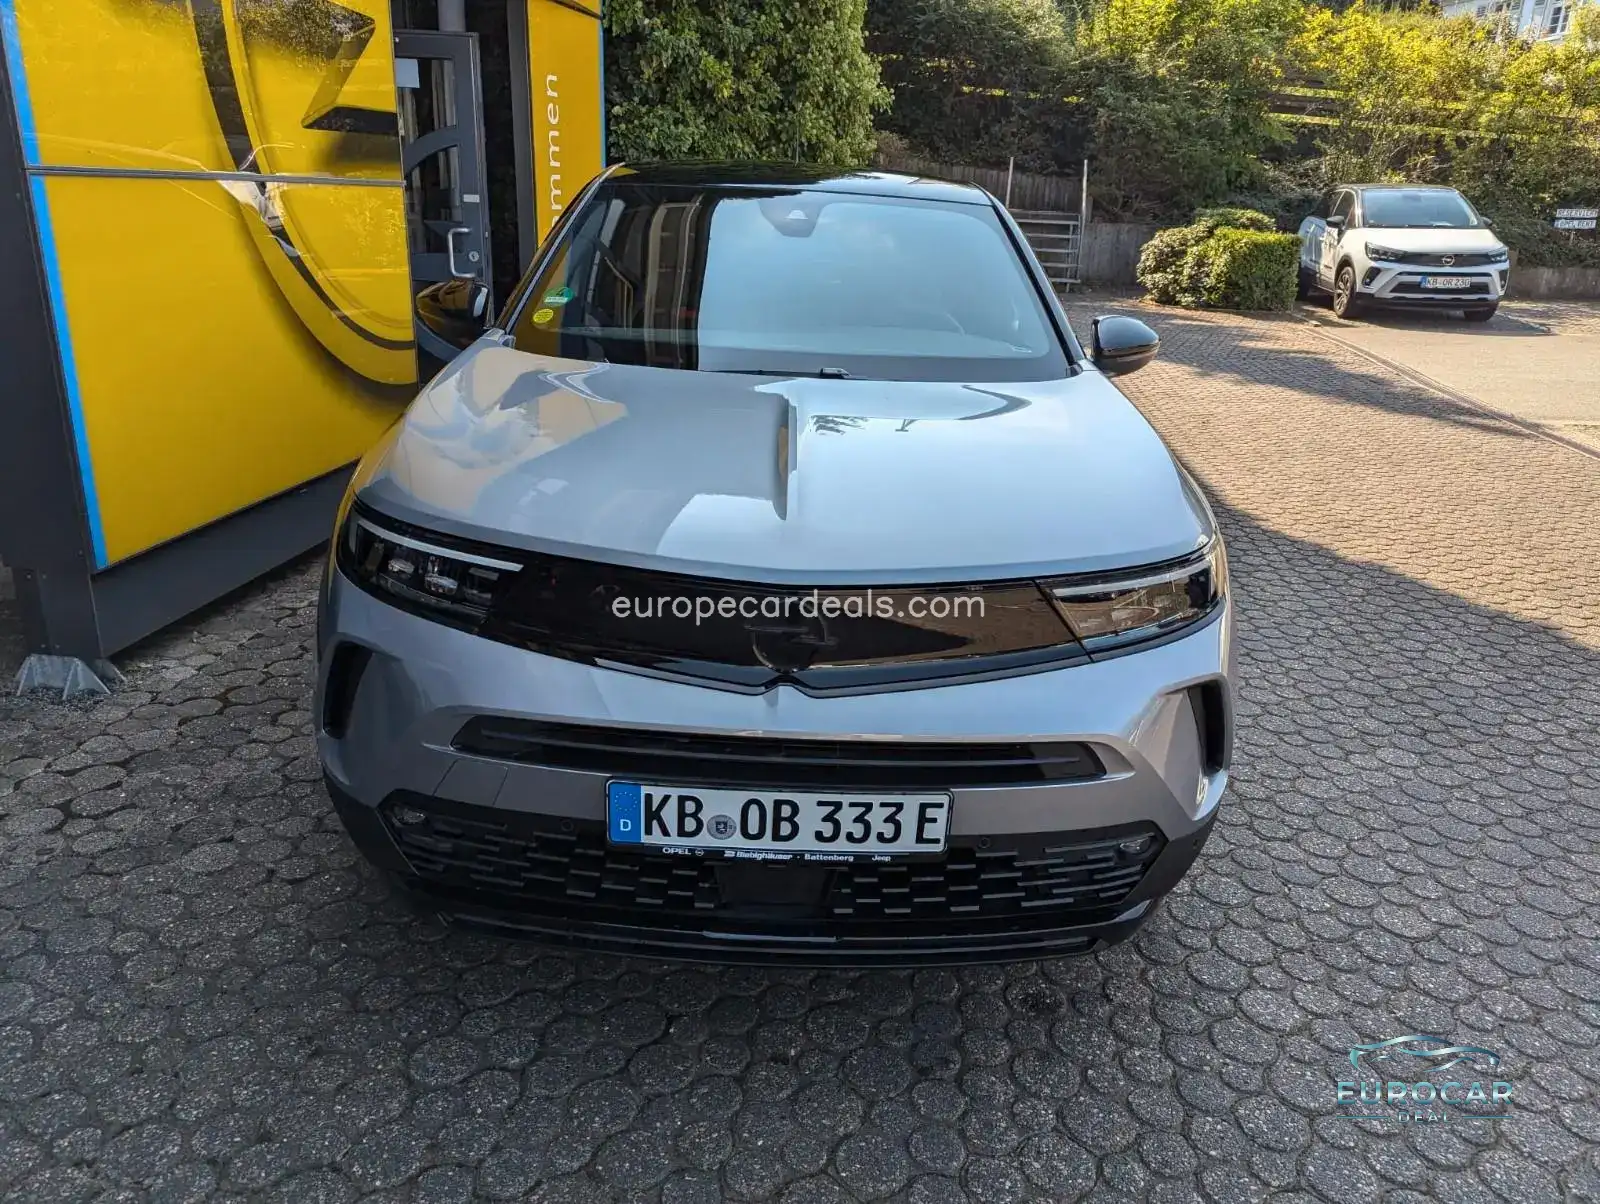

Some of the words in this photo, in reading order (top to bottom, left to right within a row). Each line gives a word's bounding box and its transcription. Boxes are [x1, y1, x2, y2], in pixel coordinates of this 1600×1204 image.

[644, 792, 705, 838] KB
[740, 797, 800, 842] OB
[814, 800, 905, 844] 333
[915, 802, 945, 844] E
[619, 818, 632, 831] D
[662, 847, 692, 855] OPEL
[804, 853, 854, 862] Battenberg
[871, 854, 892, 862] Jeep
